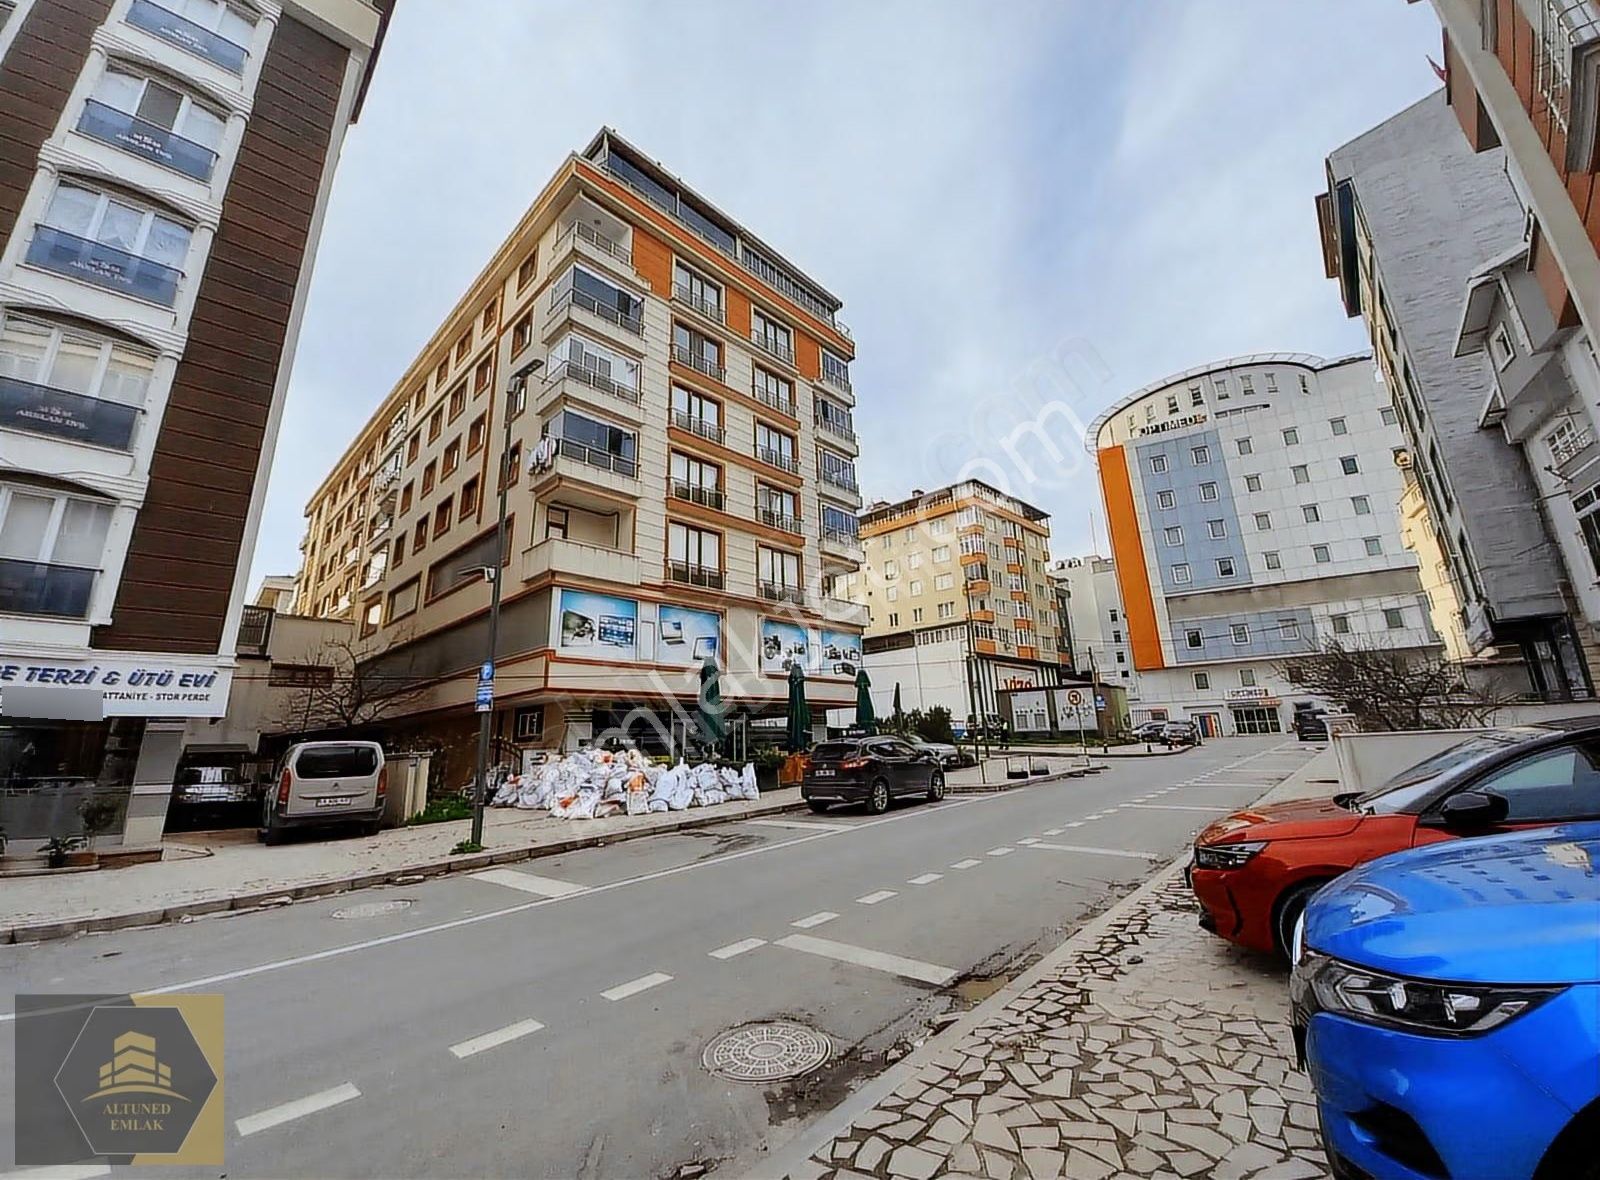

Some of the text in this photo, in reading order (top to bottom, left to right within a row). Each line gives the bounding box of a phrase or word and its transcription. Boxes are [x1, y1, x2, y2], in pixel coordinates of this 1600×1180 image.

[25, 666, 100, 685] TERZİ
[102, 671, 121, 686] &
[127, 669, 175, 687] ÜTÜ
[178, 670, 219, 688] EVİ
[103, 691, 148, 701] ATTANİYE
[155, 692, 180, 702] STOR
